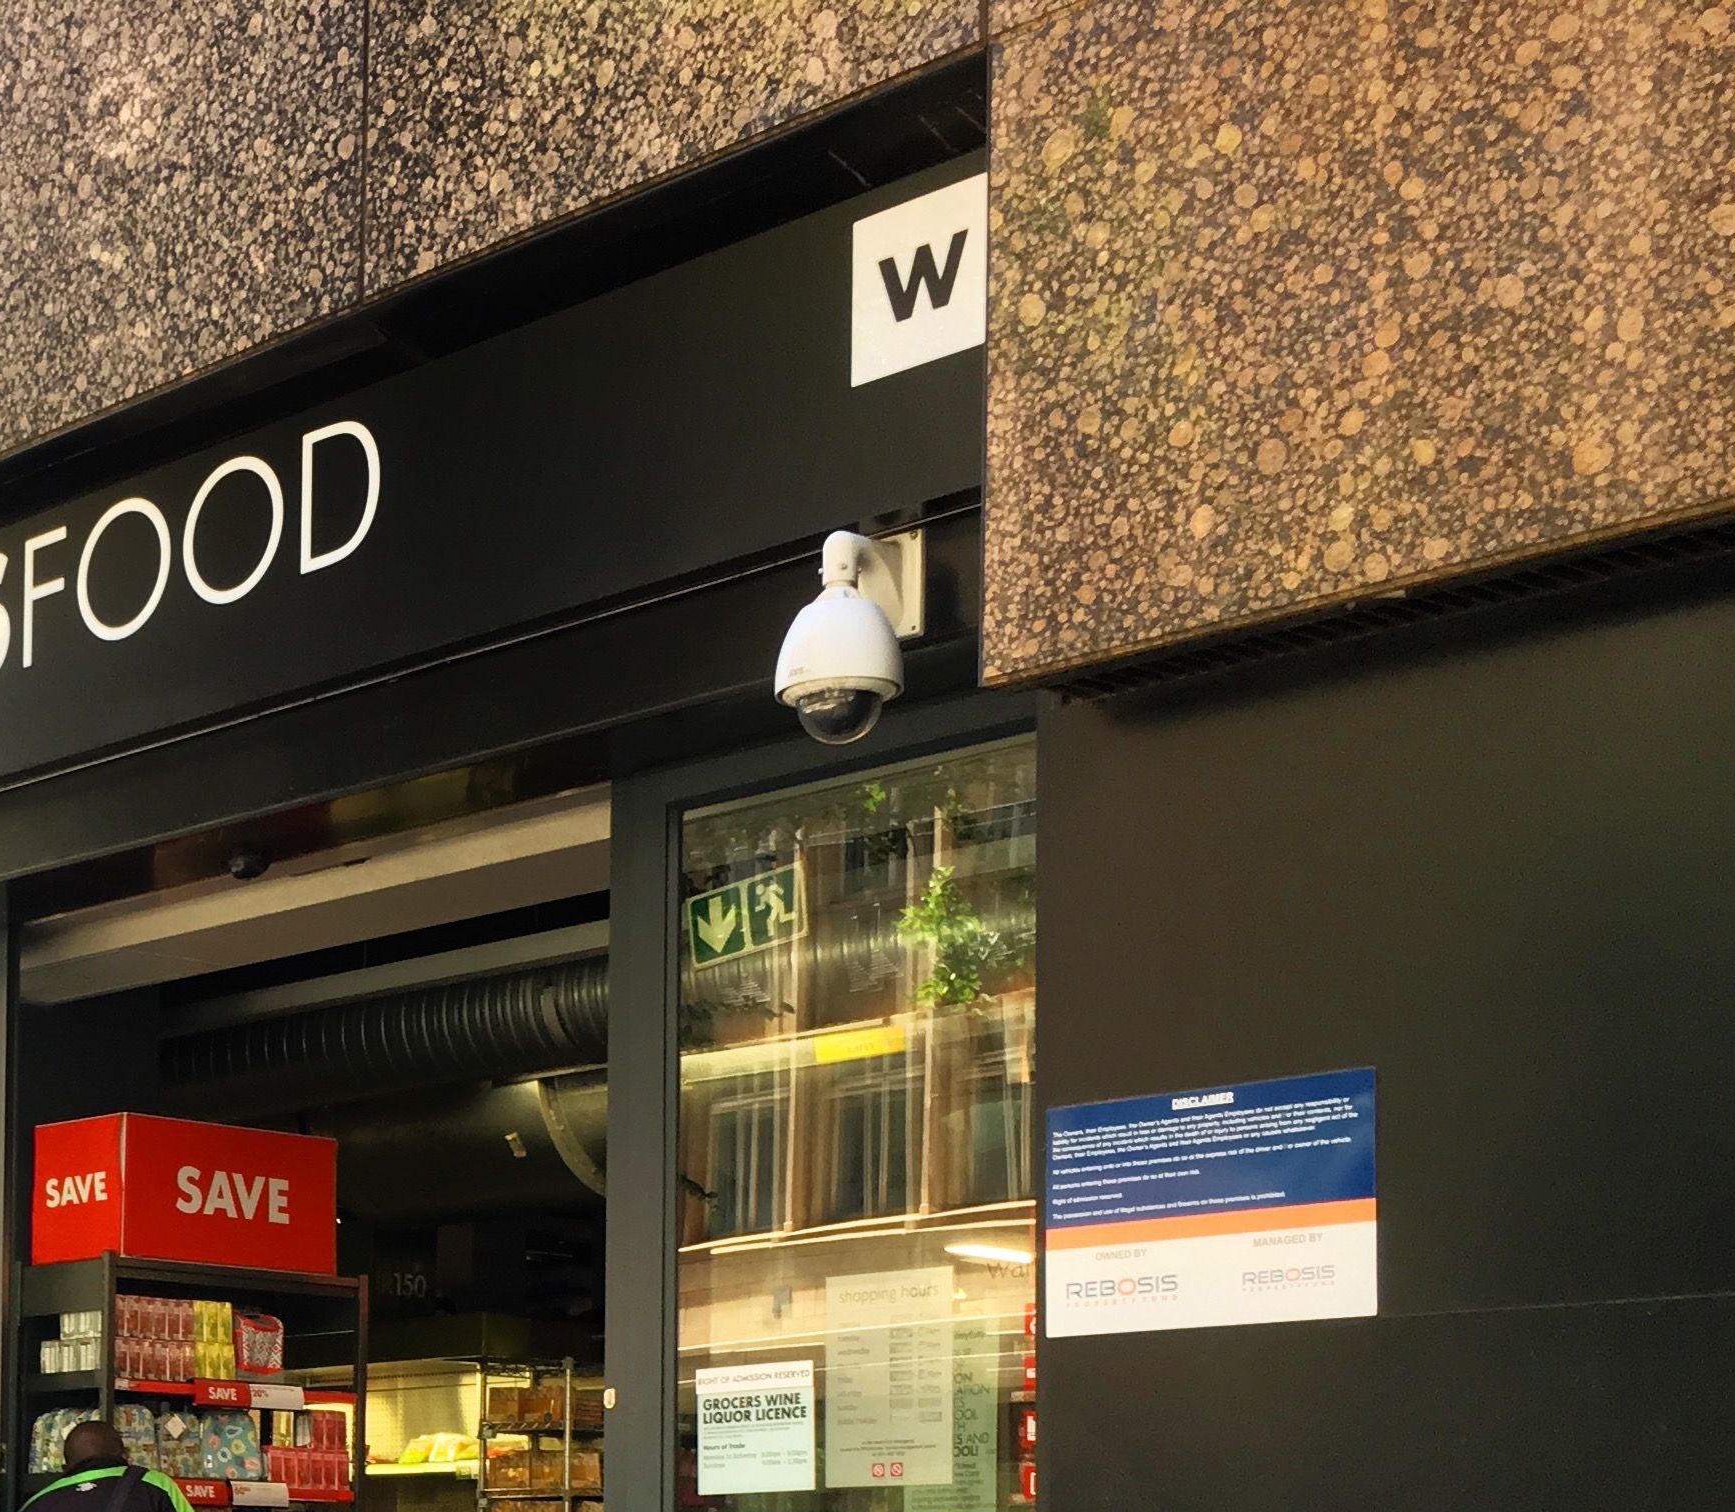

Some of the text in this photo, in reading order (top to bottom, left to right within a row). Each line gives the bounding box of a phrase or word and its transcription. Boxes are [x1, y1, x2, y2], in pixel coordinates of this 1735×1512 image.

[878, 228, 969, 323] W
[1171, 1092, 1234, 1111] DISCLAIMER
[45, 1171, 108, 1208] SAVE
[176, 1165, 290, 1225] SAVE
[1253, 1232, 1323, 1247] MANAGED BY
[1095, 1248, 1147, 1262] OWNED BY
[1242, 1265, 1336, 1285] REBOSIS
[839, 1285, 939, 1304] shopping hours
[1066, 1274, 1179, 1300] REBOSIS
[208, 1386, 237, 1401] SAVE
[703, 1392, 802, 1411] GROCERS WINE
[703, 1406, 807, 1425] LIQUOR LICENCE
[185, 1485, 215, 1498] SAVE
